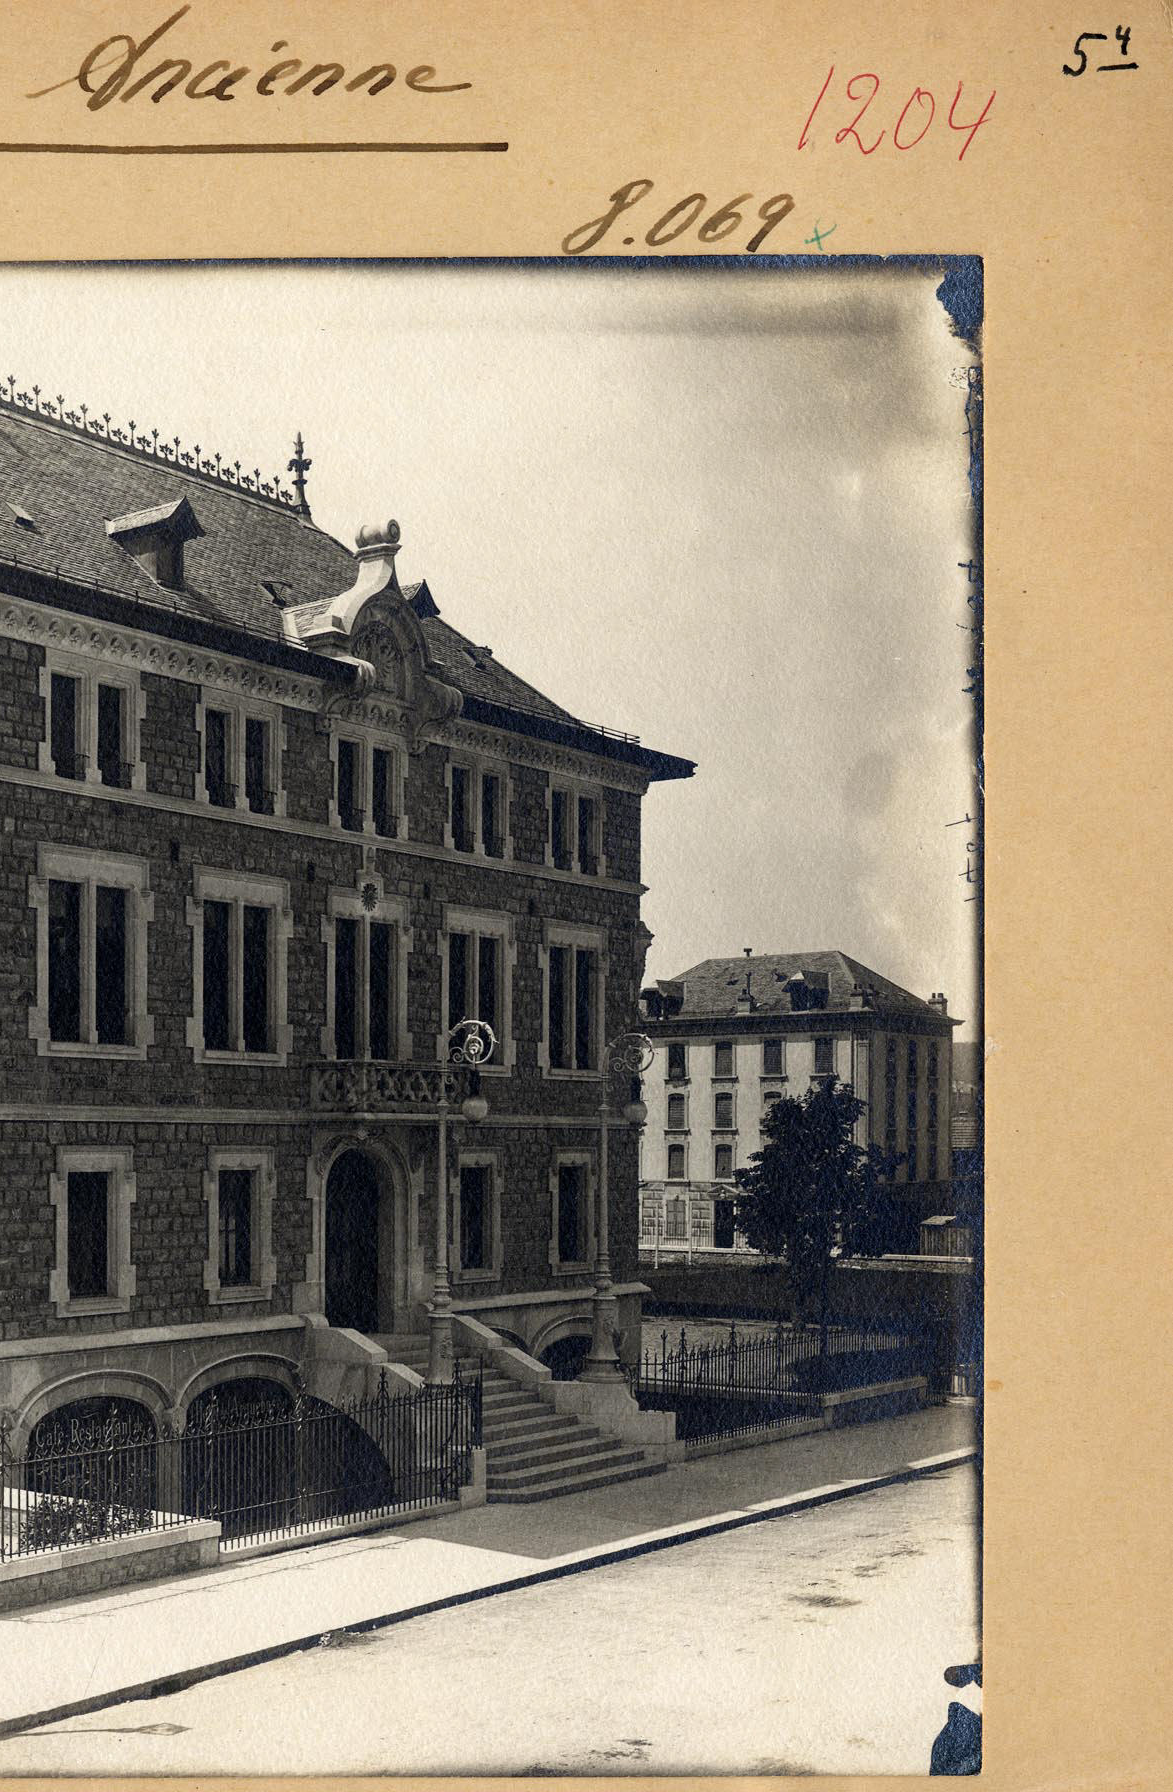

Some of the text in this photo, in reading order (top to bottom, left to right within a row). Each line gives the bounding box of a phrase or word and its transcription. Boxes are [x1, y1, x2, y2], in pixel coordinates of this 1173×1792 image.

[27, 3, 473, 104] Ancienne
[795, 64, 998, 163] 1204
[561, 178, 796, 254] 8.069
